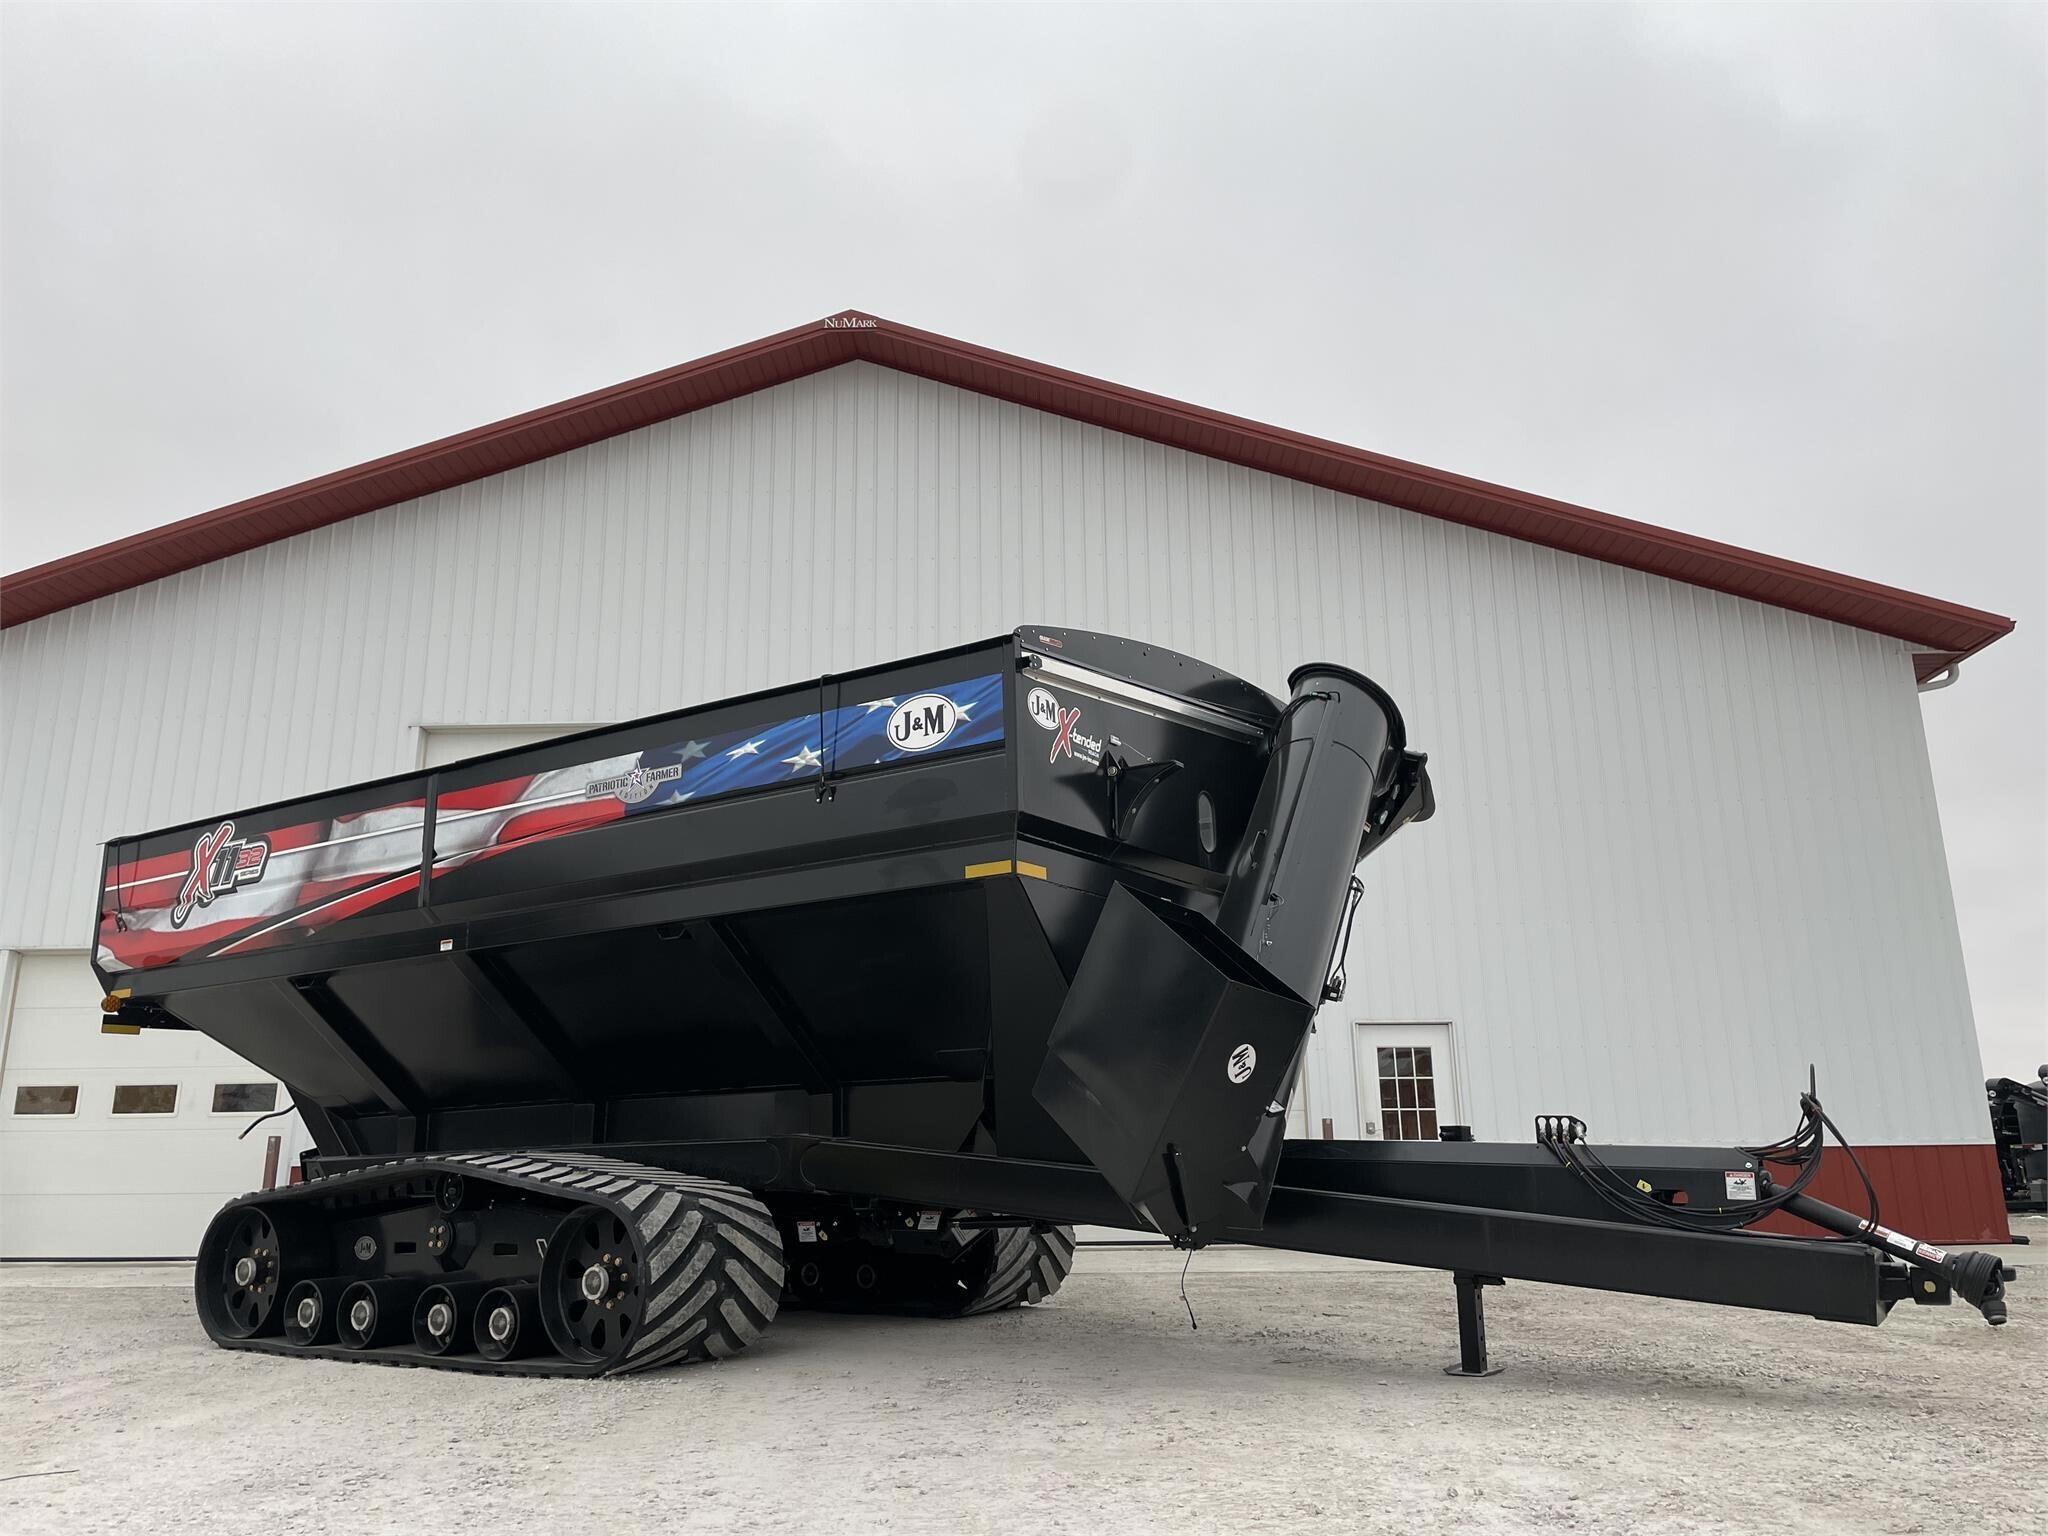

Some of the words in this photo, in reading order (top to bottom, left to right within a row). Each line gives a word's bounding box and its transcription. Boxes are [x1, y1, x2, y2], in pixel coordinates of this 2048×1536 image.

[894, 703, 946, 742] J&M
[1031, 694, 1057, 724] J&M
[588, 777, 629, 794] PATRIOTIC
[645, 766, 679, 783] FARMER
[1232, 1045, 1252, 1079] J&M
